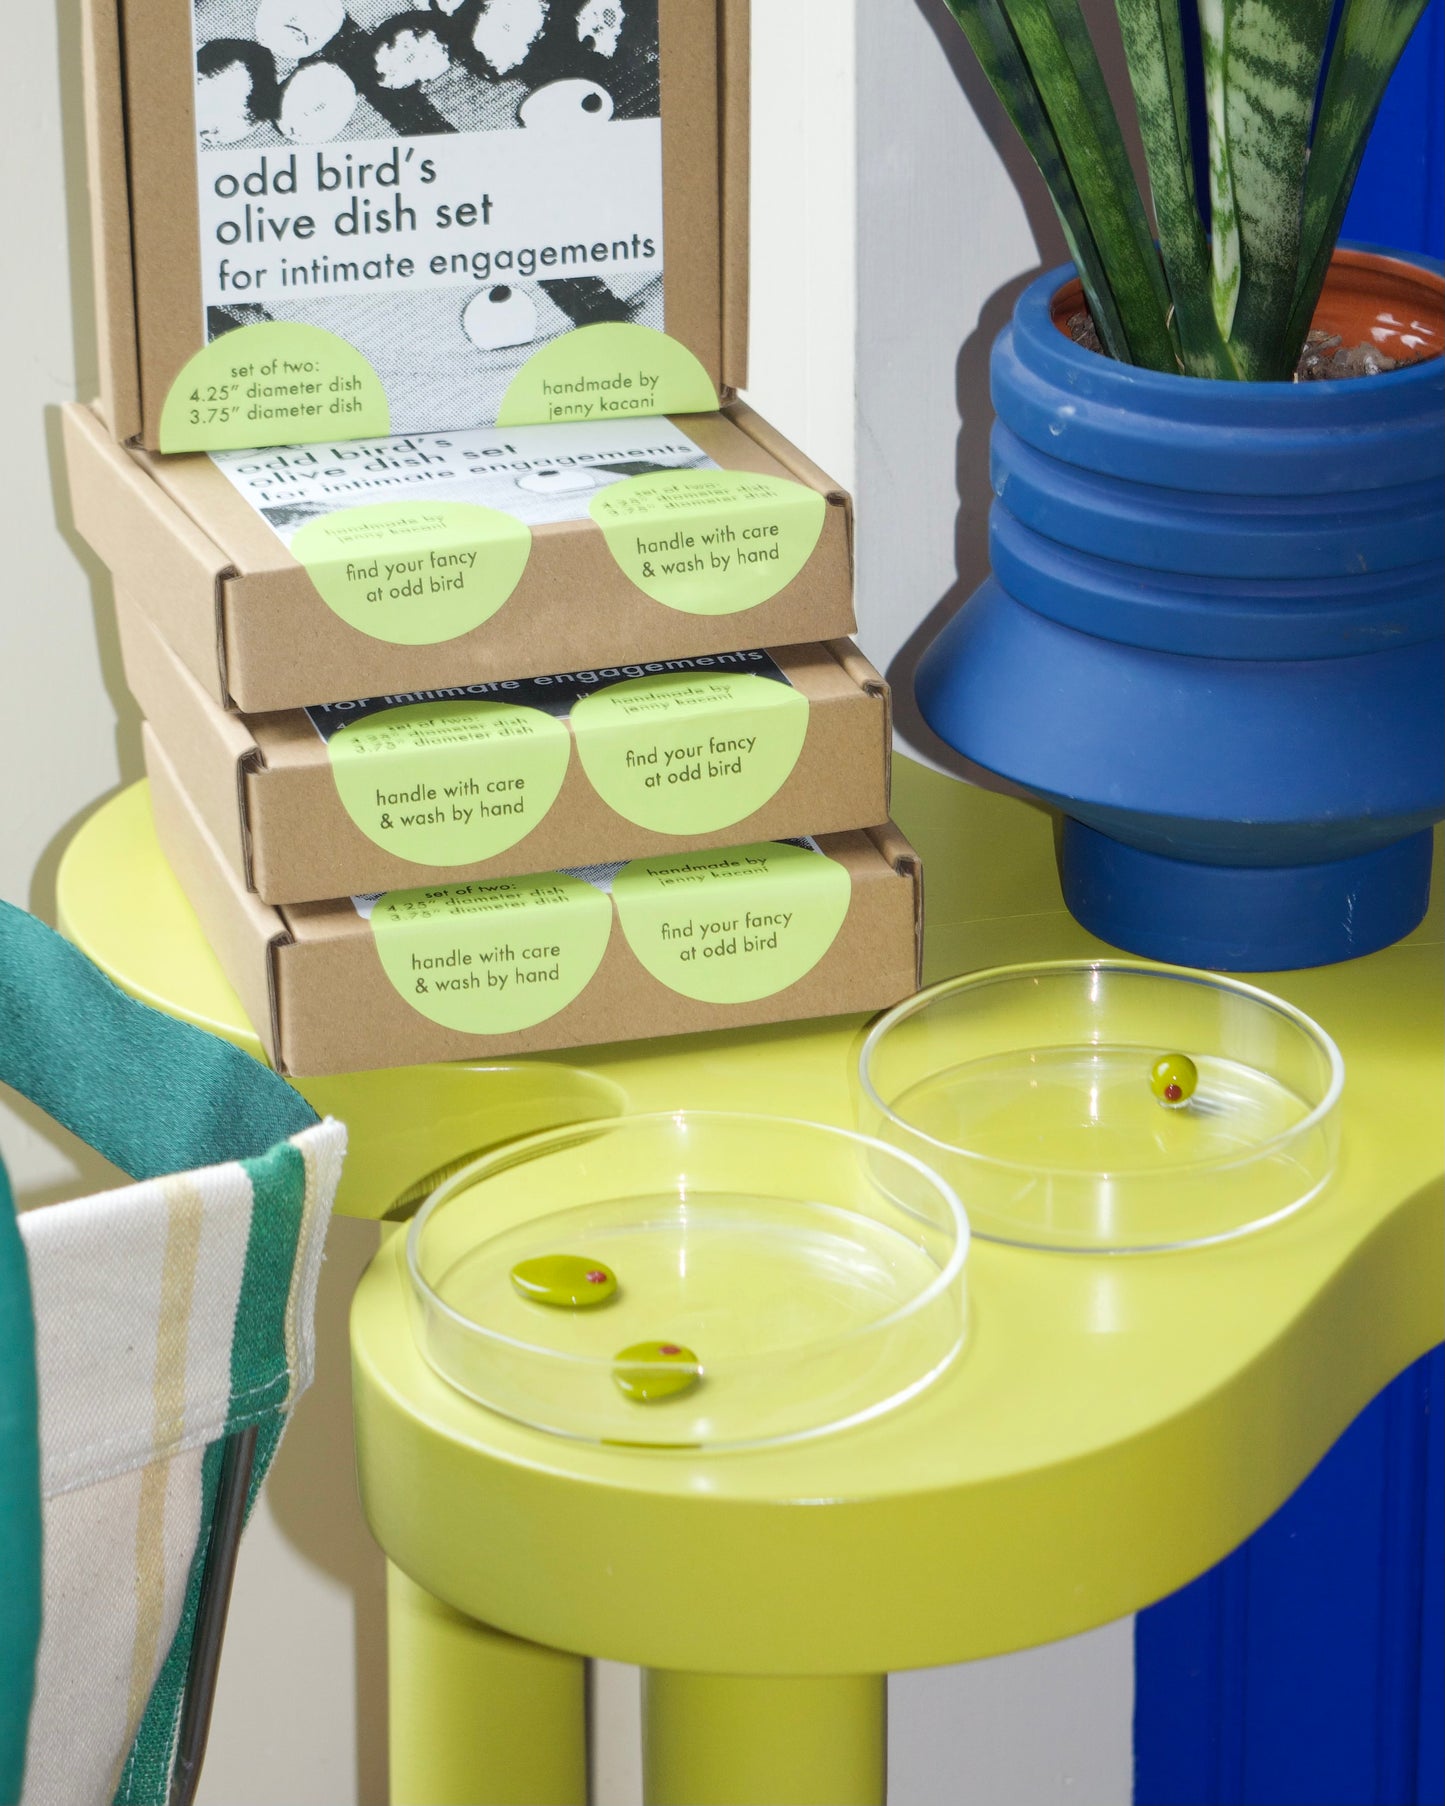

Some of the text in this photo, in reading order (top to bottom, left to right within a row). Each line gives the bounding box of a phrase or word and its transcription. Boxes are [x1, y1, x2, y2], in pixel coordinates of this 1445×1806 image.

[214, 146, 437, 198] odd bird's
[216, 192, 493, 245] olive dish set
[219, 233, 656, 291] for intimate engagements
[231, 358, 320, 378] set of two:
[543, 371, 660, 395] handmade by
[246, 381, 323, 399] diameter
[328, 375, 363, 392] dish
[247, 403, 323, 421] diameter
[329, 397, 363, 414] dish
[549, 393, 655, 420] jenny kacani
[237, 451, 318, 475] odd
[249, 444, 518, 488] olive dish set
[260, 445, 693, 501] for intimate engagements
[636, 524, 779, 555] handle with care
[346, 551, 477, 581] find your fancy
[642, 543, 780, 578] & wash by hand
[366, 571, 464, 603] at odd bird
[384, 679, 520, 704] intimate
[533, 651, 763, 685] engagements
[626, 736, 756, 768] find your fancy
[645, 757, 742, 788] at odd bird
[376, 777, 525, 806] handle with care
[380, 797, 524, 830] & wash by hand
[647, 857, 768, 877] handmade by
[425, 883, 517, 899] set of two:
[445, 892, 522, 906] diameter
[530, 887, 565, 897] dish
[661, 912, 793, 940] find your fancy
[411, 944, 561, 970] handle with care
[680, 932, 778, 961] at odd bird
[415, 964, 560, 994] & wash by hand
